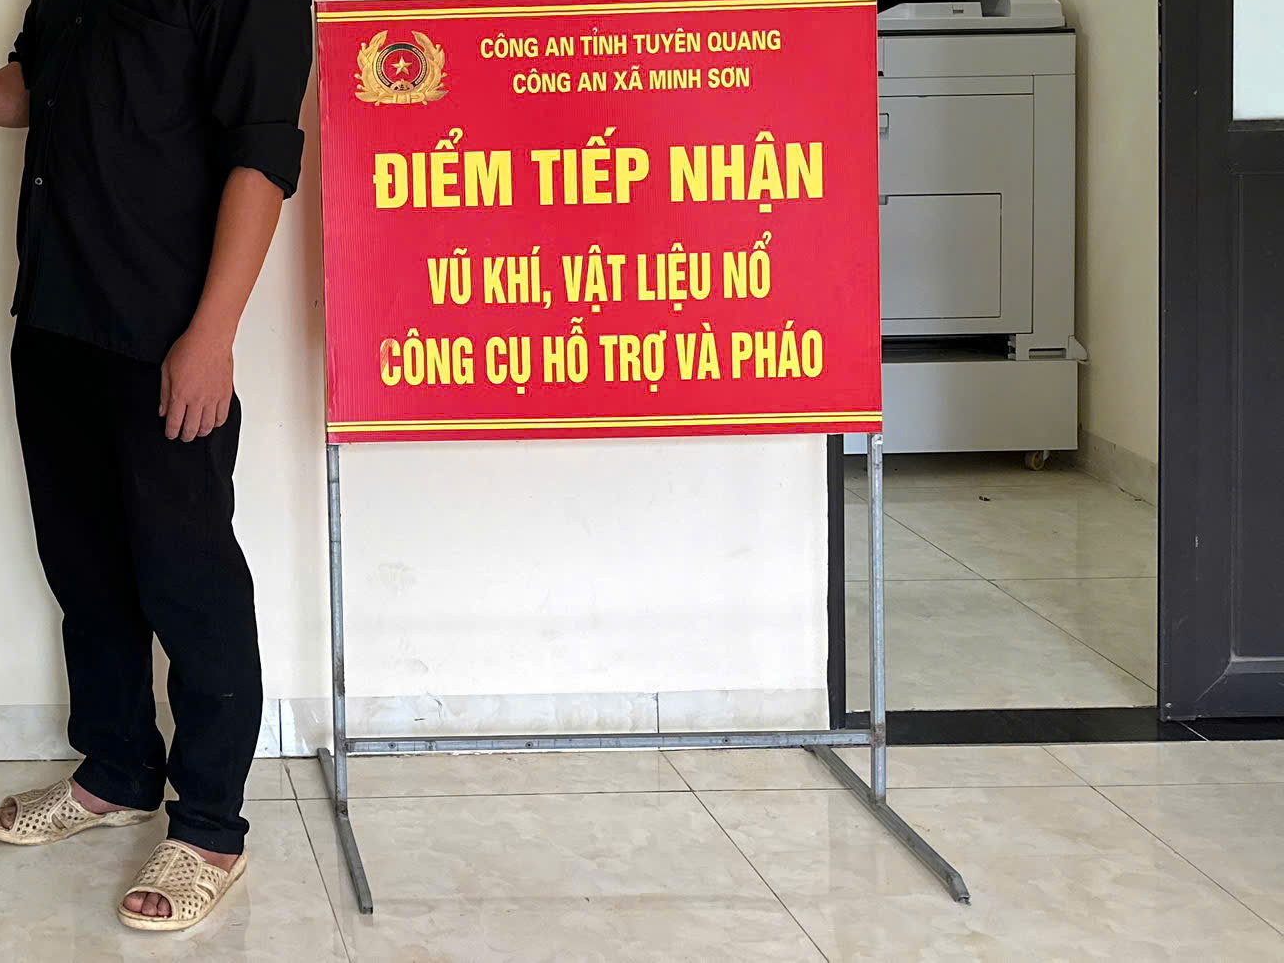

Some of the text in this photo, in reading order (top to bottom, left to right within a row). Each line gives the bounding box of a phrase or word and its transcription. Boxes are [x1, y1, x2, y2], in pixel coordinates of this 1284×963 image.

[480, 26, 781, 59] CÔNG AN TỈNH TUYÊN QUANG
[512, 65, 750, 94] CÔNG AN XÃ MINH SƠN
[372, 126, 824, 214] ĐIỂM TIẾP NHẬN
[427, 230, 773, 313] VŨ KHÍ, VẬT LIỆU NỔ
[379, 316, 823, 395] CÔNG CỤ HỖ TRỢ VÀ PHÁO
